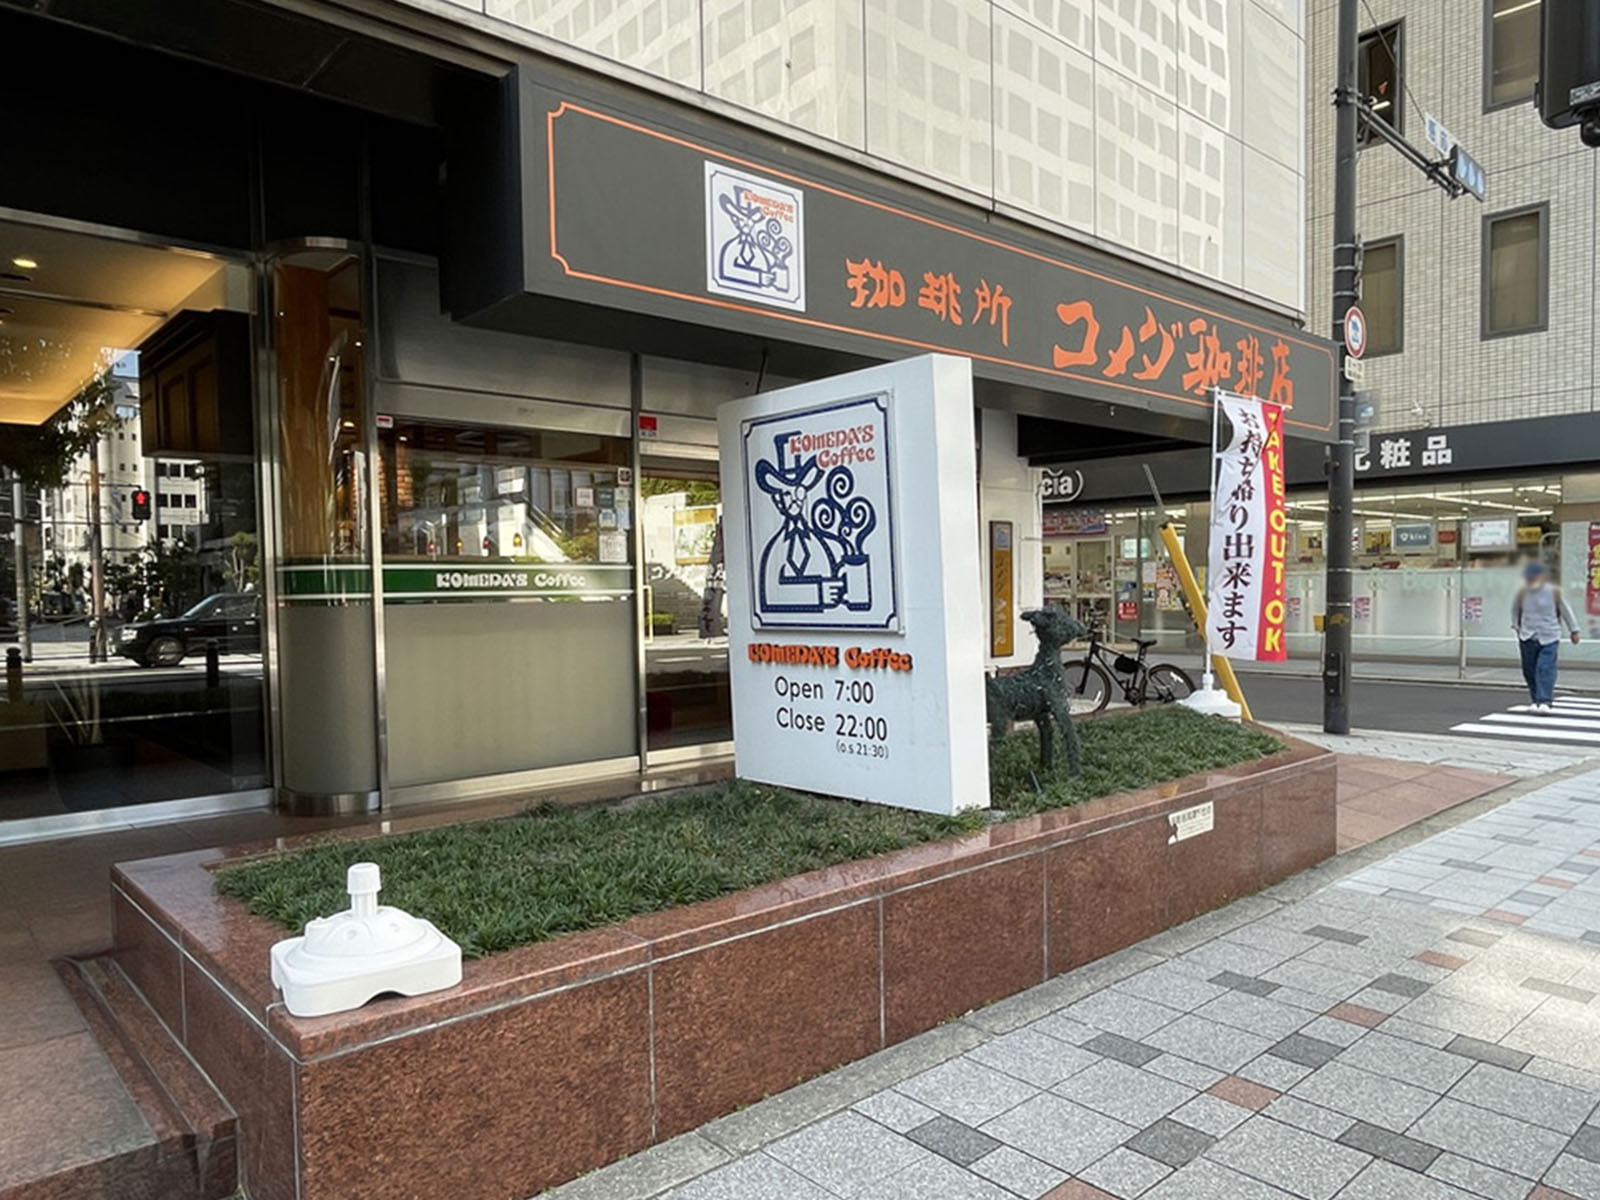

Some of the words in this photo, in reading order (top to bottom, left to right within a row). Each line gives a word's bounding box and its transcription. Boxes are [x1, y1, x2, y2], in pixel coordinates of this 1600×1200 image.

[743, 191, 793, 214] KOMEDA'S
[760, 207, 793, 223] Coffee
[845, 258, 1012, 348] 珈琲所
[1053, 300, 1293, 407] コメダ珈琲店
[789, 424, 875, 455] KOMEDA'S
[818, 446, 876, 468] Coffee
[1215, 407, 1263, 650] お持ち帰り出来ます
[436, 572, 528, 588] KOMEDA'S
[534, 572, 587, 588] Coffee
[748, 643, 839, 667] KOMEDA'S
[845, 647, 913, 672] Coffee
[774, 675, 824, 702] Open
[834, 679, 874, 704] 7:00
[776, 707, 826, 732] Close
[835, 713, 888, 741] 22:00
